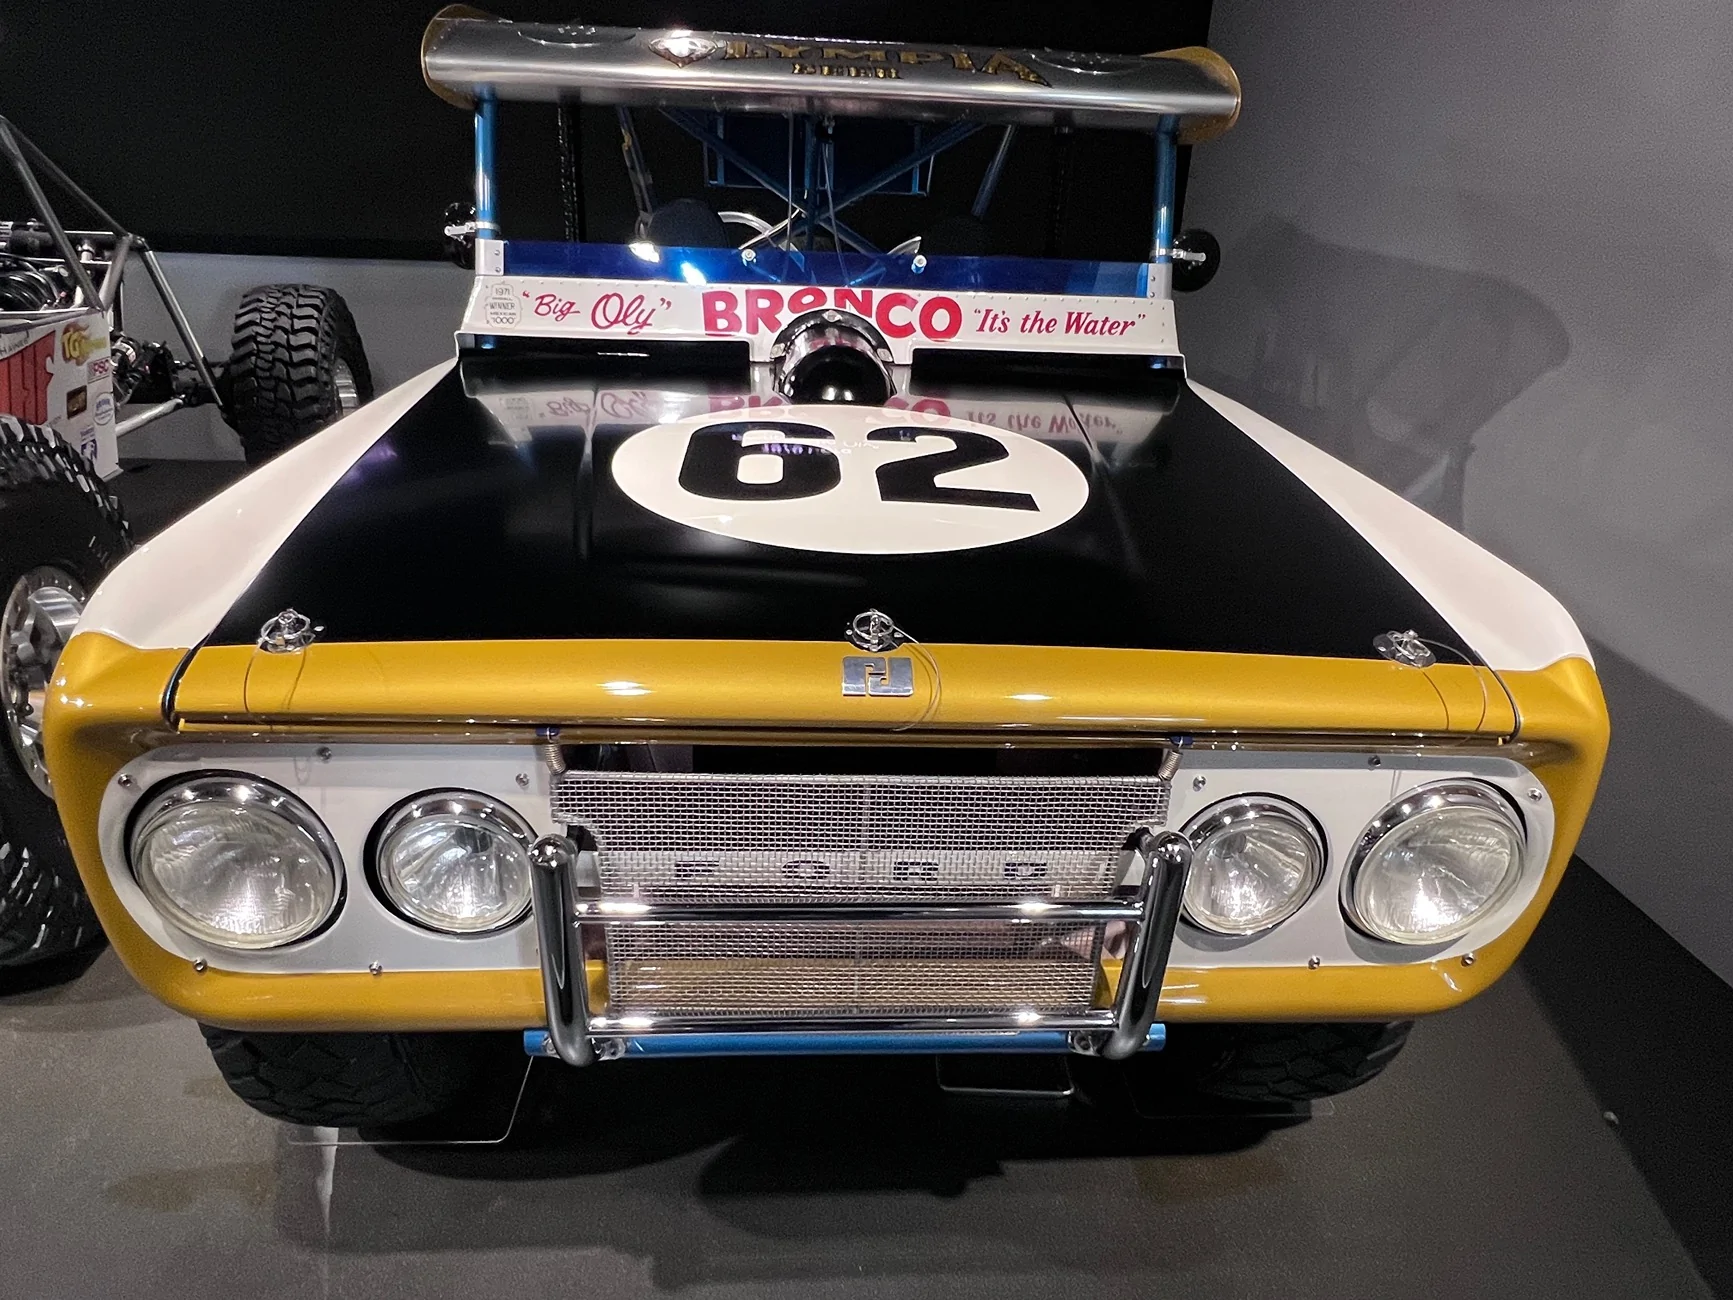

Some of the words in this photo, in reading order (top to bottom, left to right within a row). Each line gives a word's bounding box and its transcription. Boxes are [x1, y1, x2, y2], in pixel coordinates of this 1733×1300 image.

[495, 287, 511, 296] 1971
[490, 302, 515, 310] WINNER
[702, 286, 963, 342] BRONCO
[1019, 310, 1058, 334] the
[678, 421, 1041, 512] 62
[674, 859, 1047, 881] FORD
